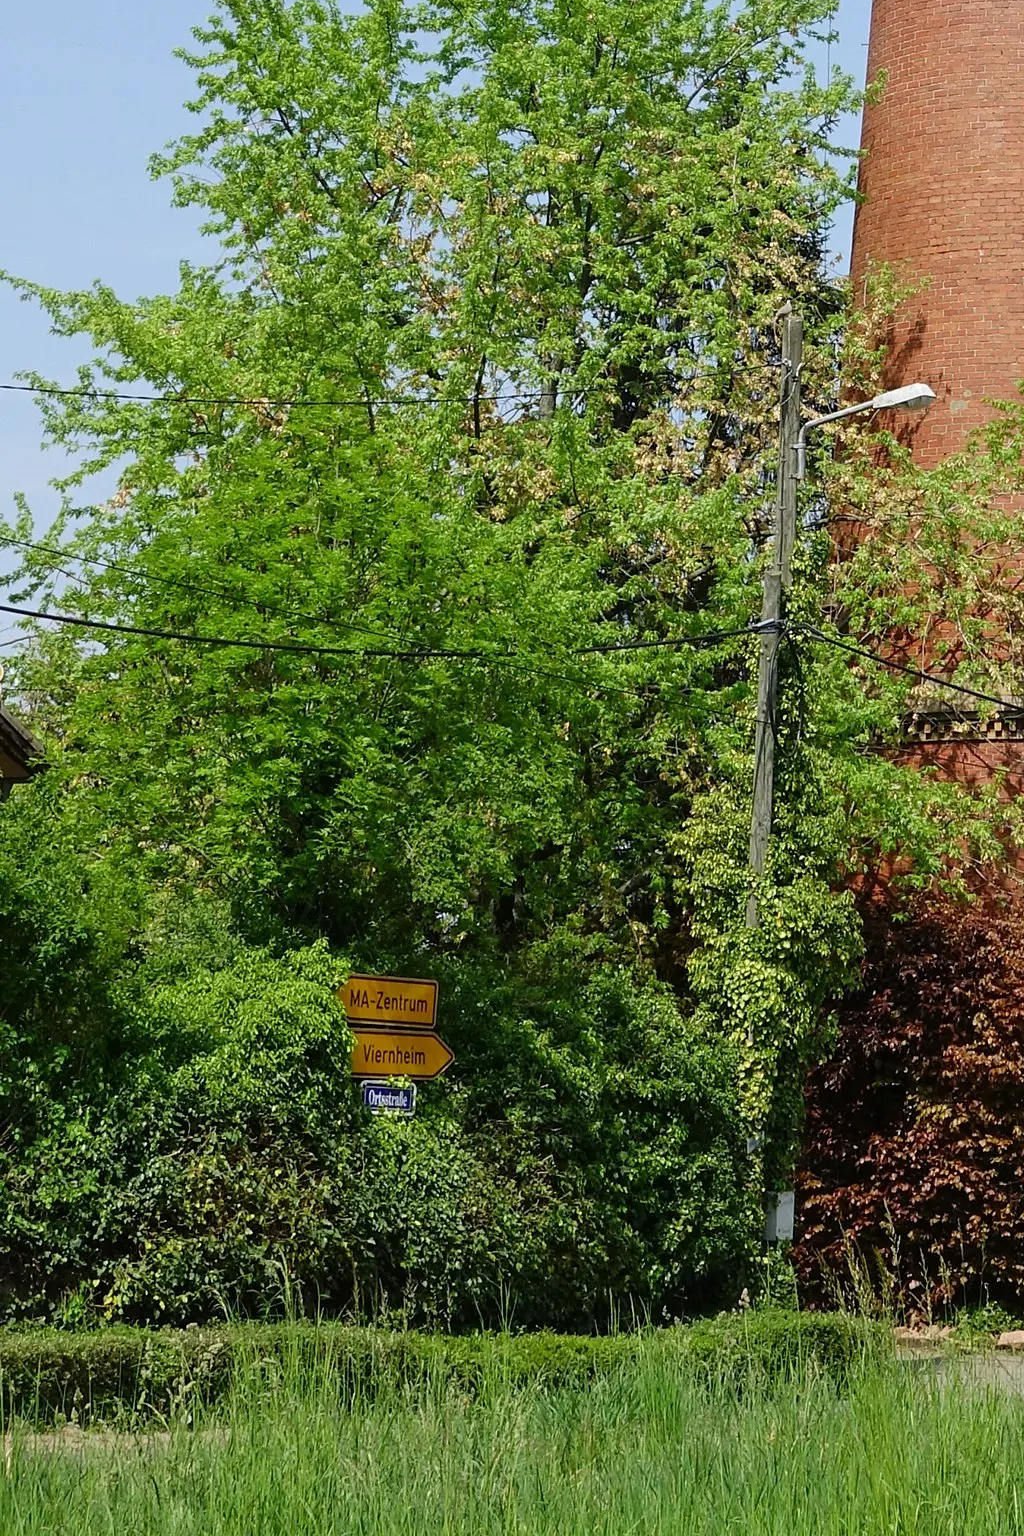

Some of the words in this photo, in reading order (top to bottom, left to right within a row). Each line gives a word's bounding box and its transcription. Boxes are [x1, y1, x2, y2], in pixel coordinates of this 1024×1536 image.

[350, 989, 428, 1013] MA-Zentrum
[363, 1044, 426, 1065] Viernheim
[368, 1089, 408, 1108] Ortsstraße
